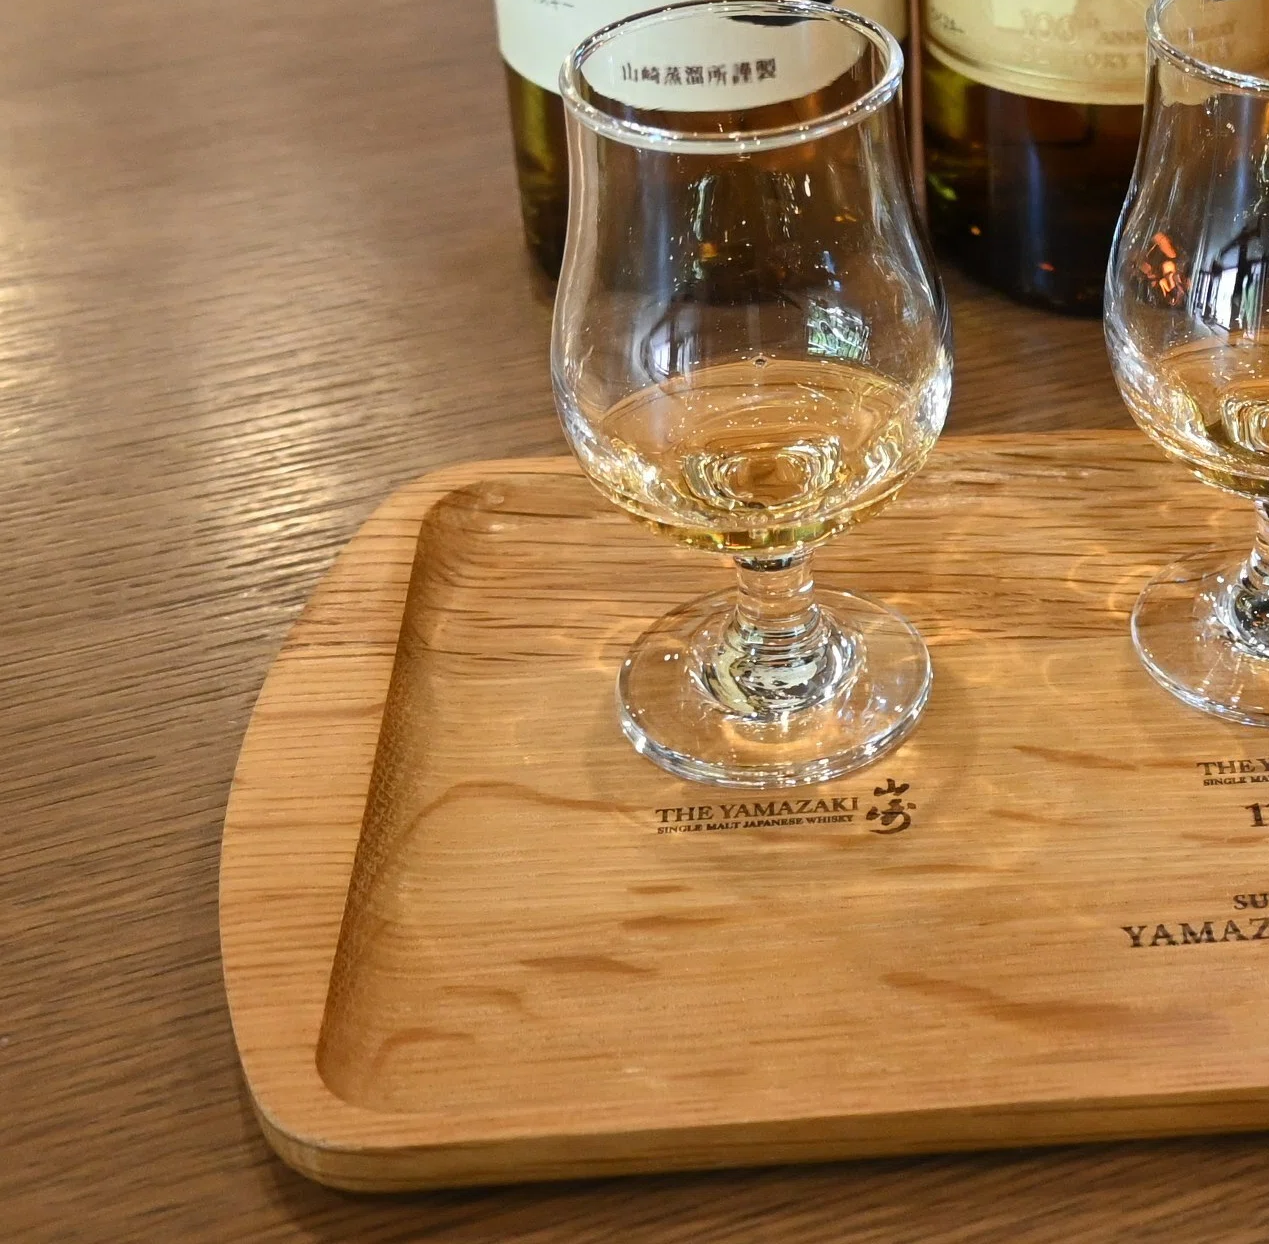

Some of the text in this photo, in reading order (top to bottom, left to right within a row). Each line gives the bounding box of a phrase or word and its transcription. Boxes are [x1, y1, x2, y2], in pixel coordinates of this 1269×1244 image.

[1196, 759, 1256, 776] THE
[1203, 776, 1248, 787] SINGLE
[655, 796, 859, 823] THE YAMAZAKI
[657, 814, 854, 835] SINGLE MALT JAPANESE WHISKY
